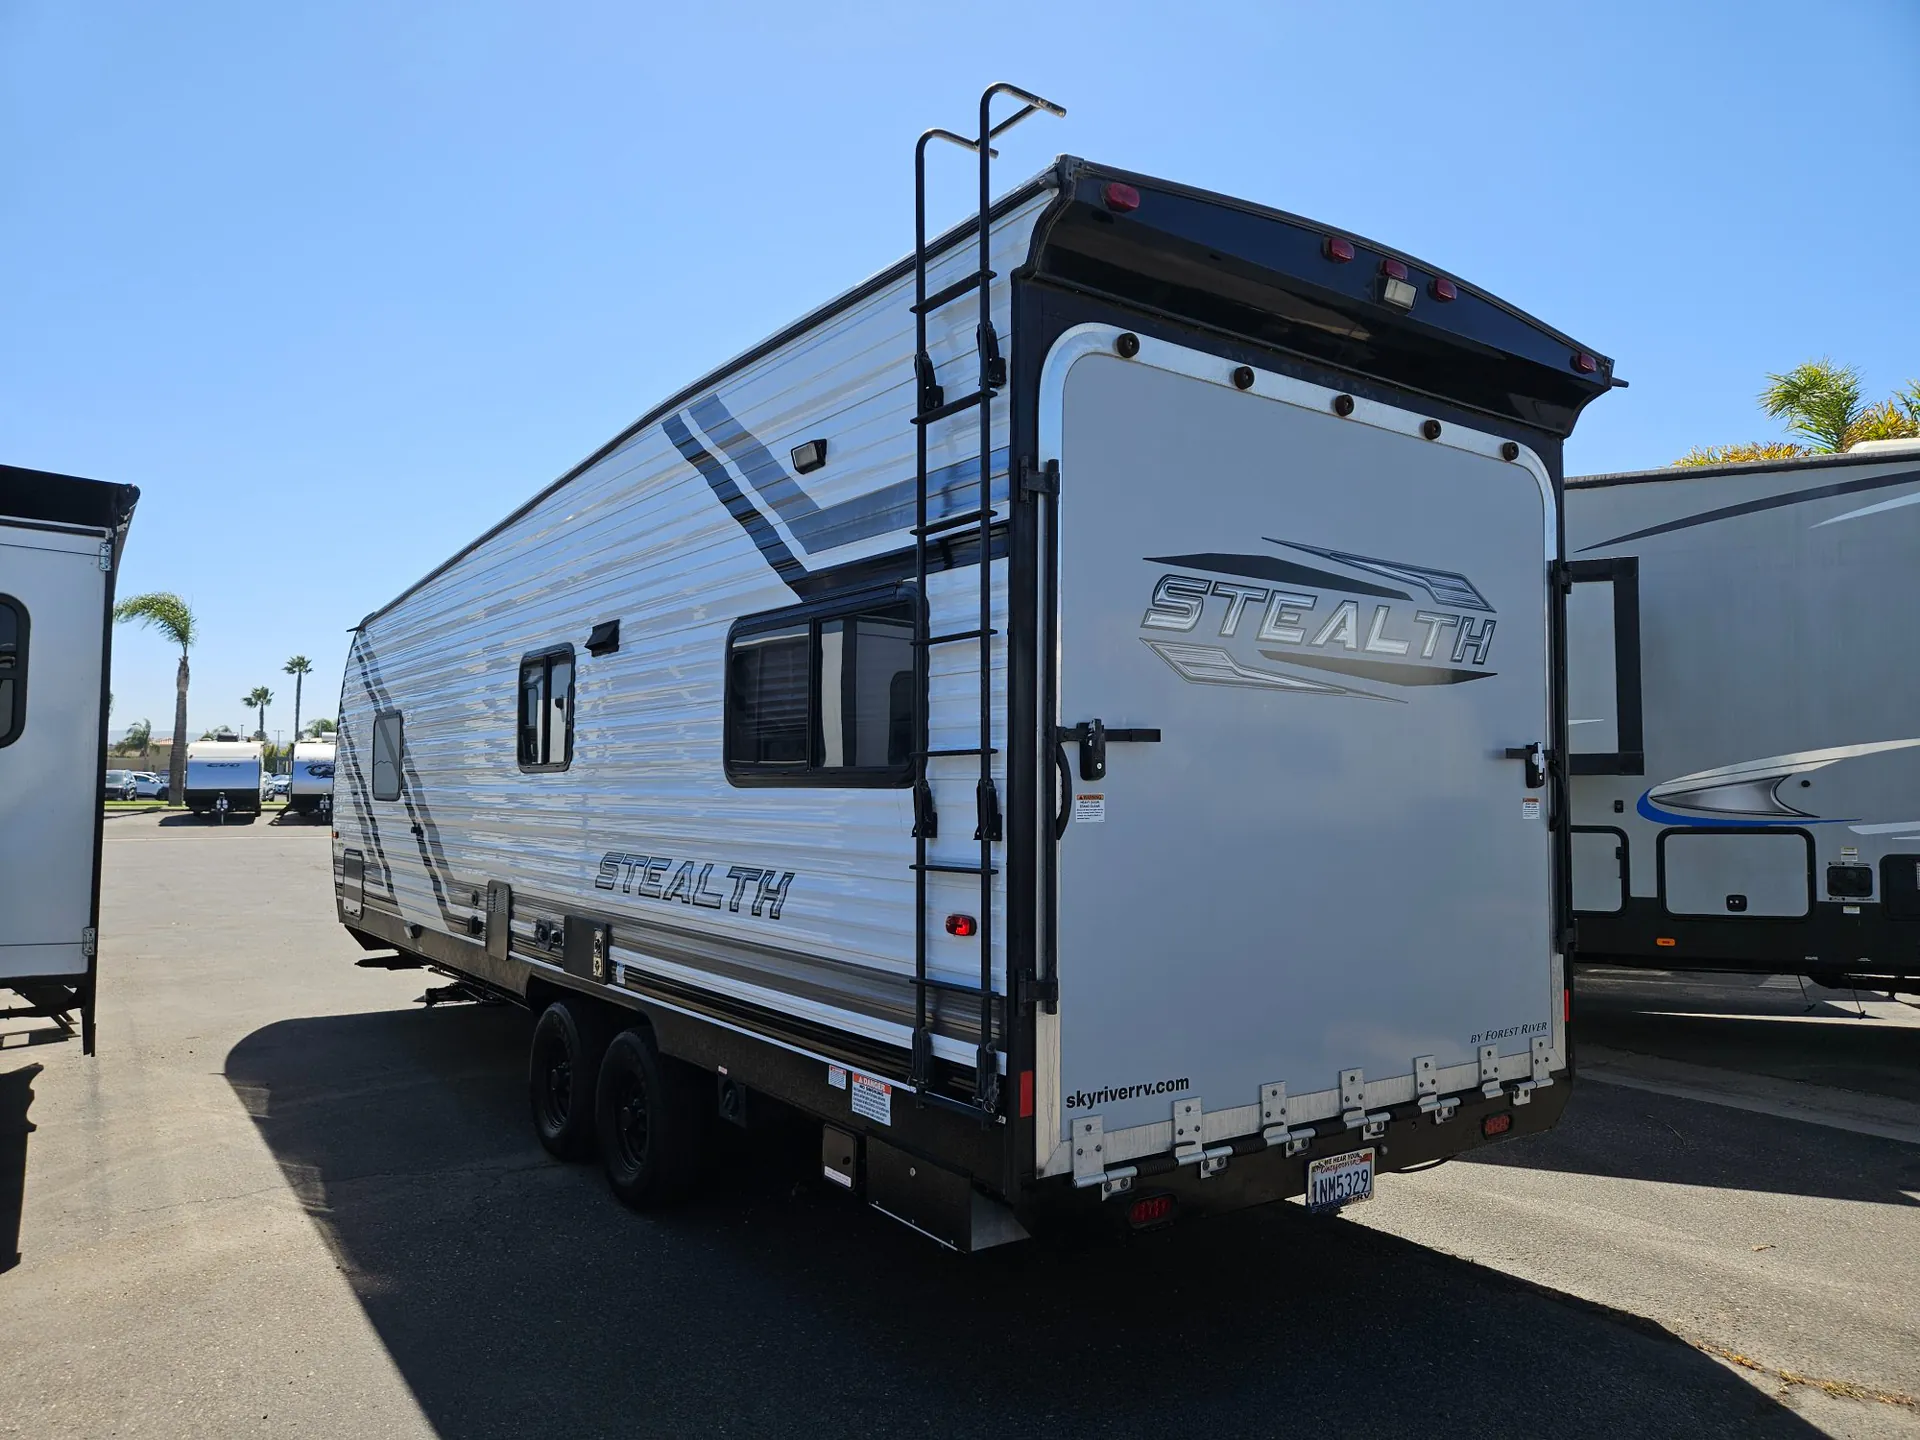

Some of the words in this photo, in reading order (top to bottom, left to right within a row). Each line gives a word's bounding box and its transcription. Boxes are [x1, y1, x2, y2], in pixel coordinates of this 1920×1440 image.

[1140, 573, 1497, 665] STEALTH
[595, 851, 796, 920] STEALTH
[1470, 1033, 1484, 1044] BY
[1485, 1027, 1520, 1041] FOREST
[1521, 1022, 1547, 1035] RIVER
[863, 1079, 885, 1092] DANGER
[1066, 1077, 1190, 1110] skyriverrv.com
[1312, 1169, 1369, 1204] 1NM5329
